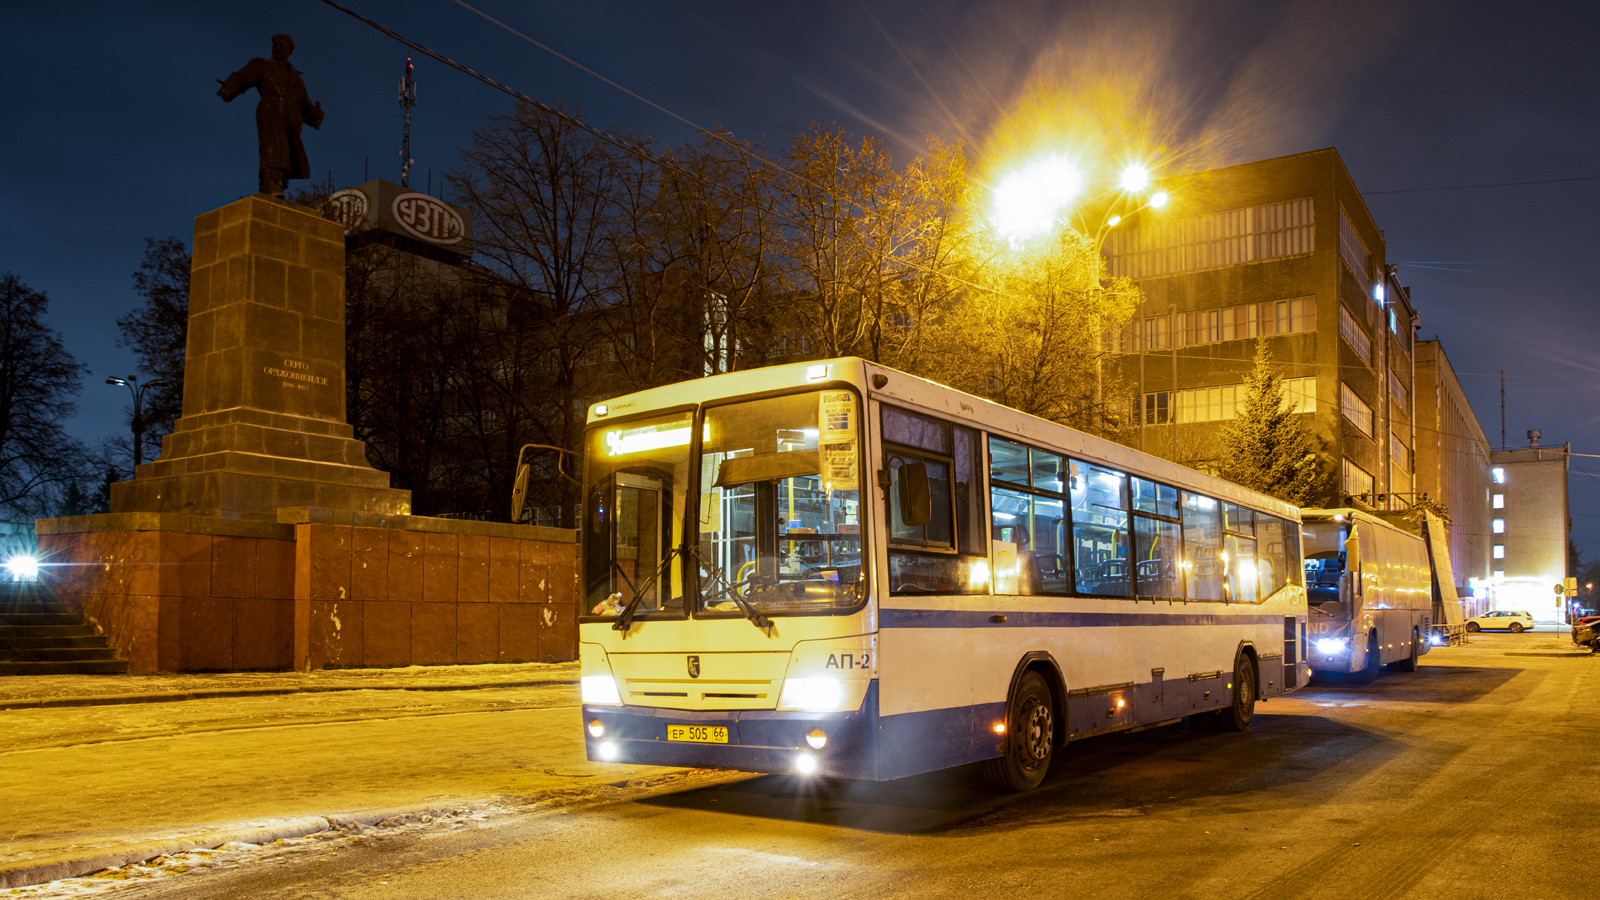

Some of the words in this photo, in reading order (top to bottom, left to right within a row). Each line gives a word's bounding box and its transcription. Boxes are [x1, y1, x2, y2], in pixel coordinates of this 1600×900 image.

[400, 200, 460, 237] УЗТМ
[284, 359, 309, 370] СЕРГО
[263, 366, 329, 386] ОРДЖОНИКИДЗЕ
[825, 653, 870, 669] АП-2
[672, 729, 685, 739] ЕР
[689, 727, 708, 740] 505
[713, 727, 724, 738] 66
